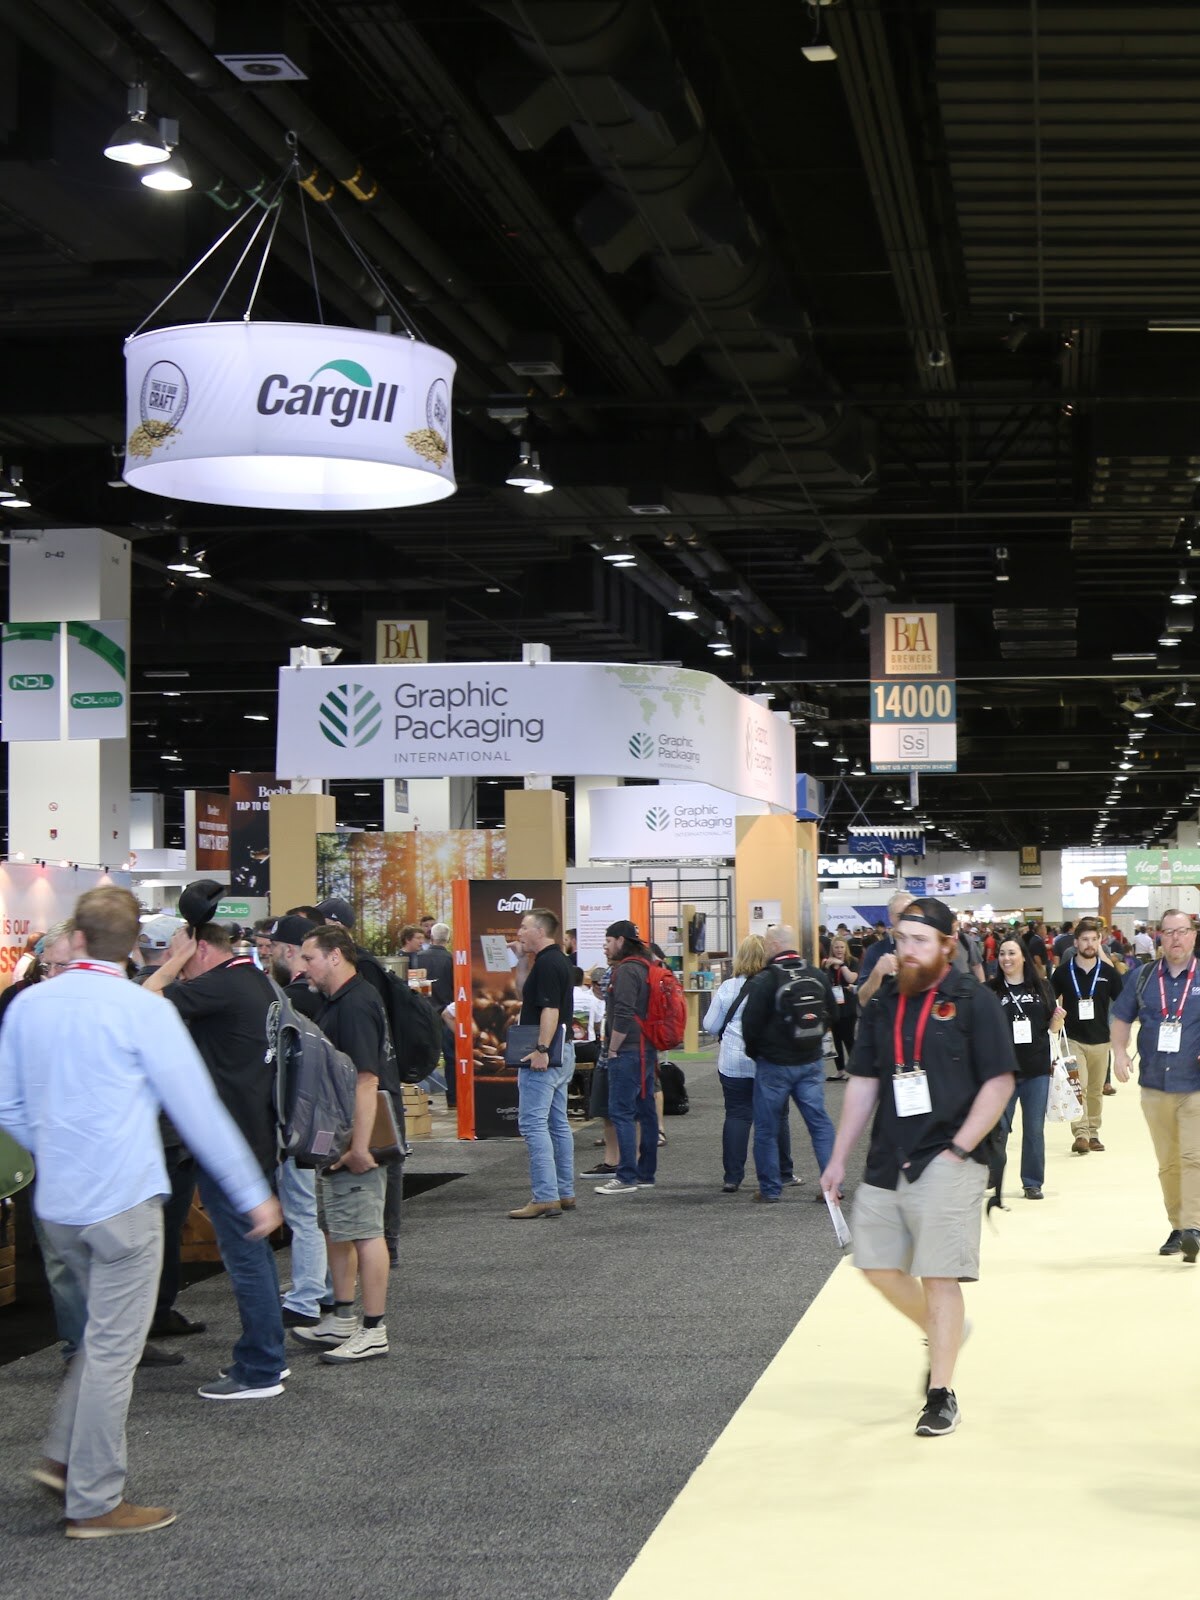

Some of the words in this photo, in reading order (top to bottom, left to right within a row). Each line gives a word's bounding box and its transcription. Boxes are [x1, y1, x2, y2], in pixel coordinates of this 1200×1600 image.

[256, 373, 399, 428] Cargill
[891, 654, 933, 664] BREWERS
[394, 680, 509, 712] Graphic
[874, 684, 952, 718] 14000
[394, 711, 544, 744] Packaging
[658, 733, 694, 748] Graphic
[902, 734, 925, 750] Ss
[394, 751, 512, 763] INTERNATIONAL
[658, 746, 701, 764] Packaging
[236, 801, 250, 811] TAP
[251, 801, 262, 811] TO
[674, 804, 719, 817] Graphic
[674, 816, 733, 829] Packaging
[817, 857, 882, 875] PakTech
[1134, 860, 1161, 875] Hop
[496, 898, 535, 915] Cargill
[14, 919, 31, 935] our
